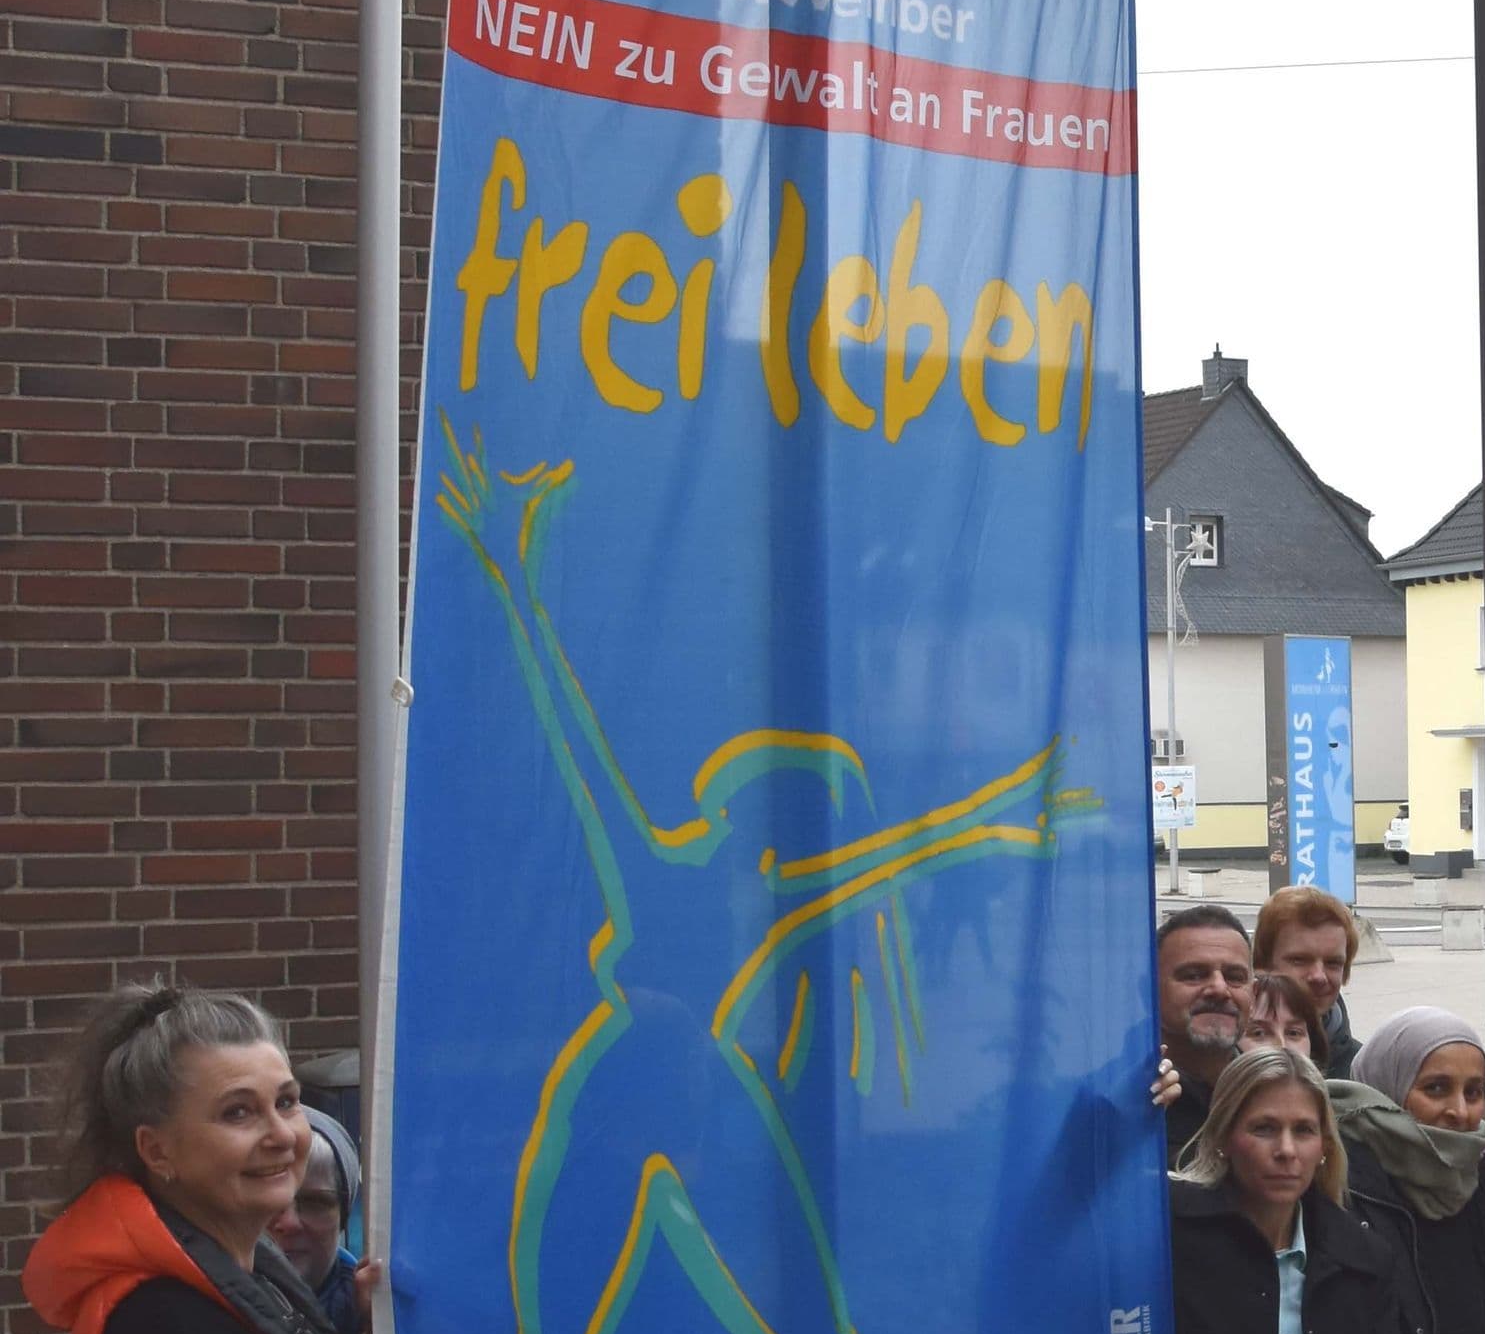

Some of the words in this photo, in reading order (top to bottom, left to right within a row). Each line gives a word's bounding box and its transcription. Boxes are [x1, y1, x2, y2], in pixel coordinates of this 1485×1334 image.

[616, 42, 675, 87] zu
[700, 43, 880, 118] Gewalt
[889, 84, 942, 131] an
[962, 89, 1111, 154] Frauen
[457, 137, 733, 415] frei
[760, 179, 1095, 452] leben
[1294, 712, 1315, 887] RATHAUS
